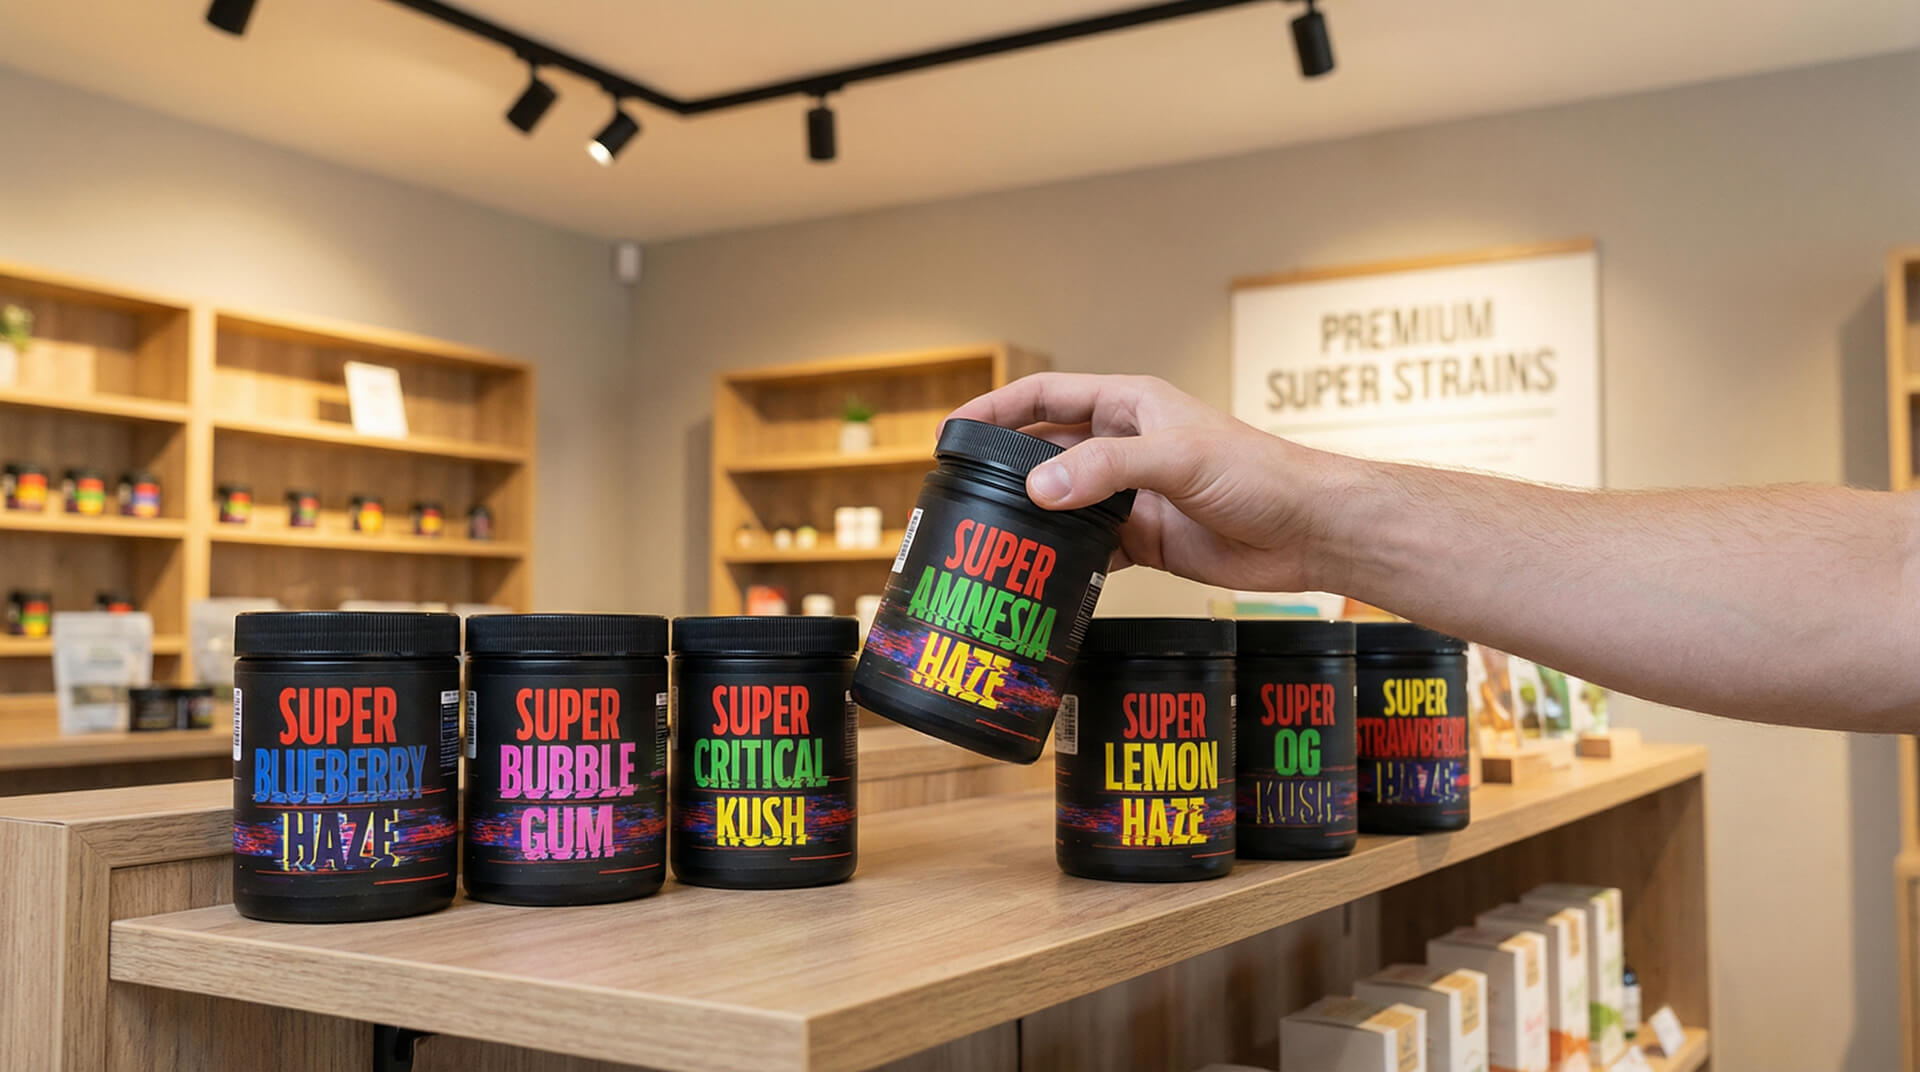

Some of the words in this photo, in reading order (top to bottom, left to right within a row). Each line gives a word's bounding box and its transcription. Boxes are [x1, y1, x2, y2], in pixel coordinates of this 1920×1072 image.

[1320, 300, 1494, 351] PREMIUM
[1266, 365, 1380, 411] SUPER
[1394, 350, 1557, 400] STRAINS
[945, 518, 1056, 600] SUPER
[906, 565, 1056, 662] AMNESIA
[911, 631, 1012, 710] HAZE
[279, 687, 398, 745] SUPER
[515, 687, 621, 741] SUPER
[712, 685, 810, 736] SUPER
[1123, 692, 1207, 739] SUPER
[1260, 683, 1336, 727] SUPER
[1382, 678, 1448, 716] SUPER
[253, 745, 427, 804] BLUEBERRY
[499, 742, 638, 799] BUBBLE
[694, 738, 829, 789] CRITICAL
[1105, 740, 1218, 791] LEMON
[1274, 728, 1321, 776] OG
[716, 796, 808, 847] KUSH
[1122, 797, 1208, 846] HAZE
[1256, 780, 1337, 825] KUSH
[282, 809, 400, 872] HAZE
[520, 806, 616, 860] GUM
